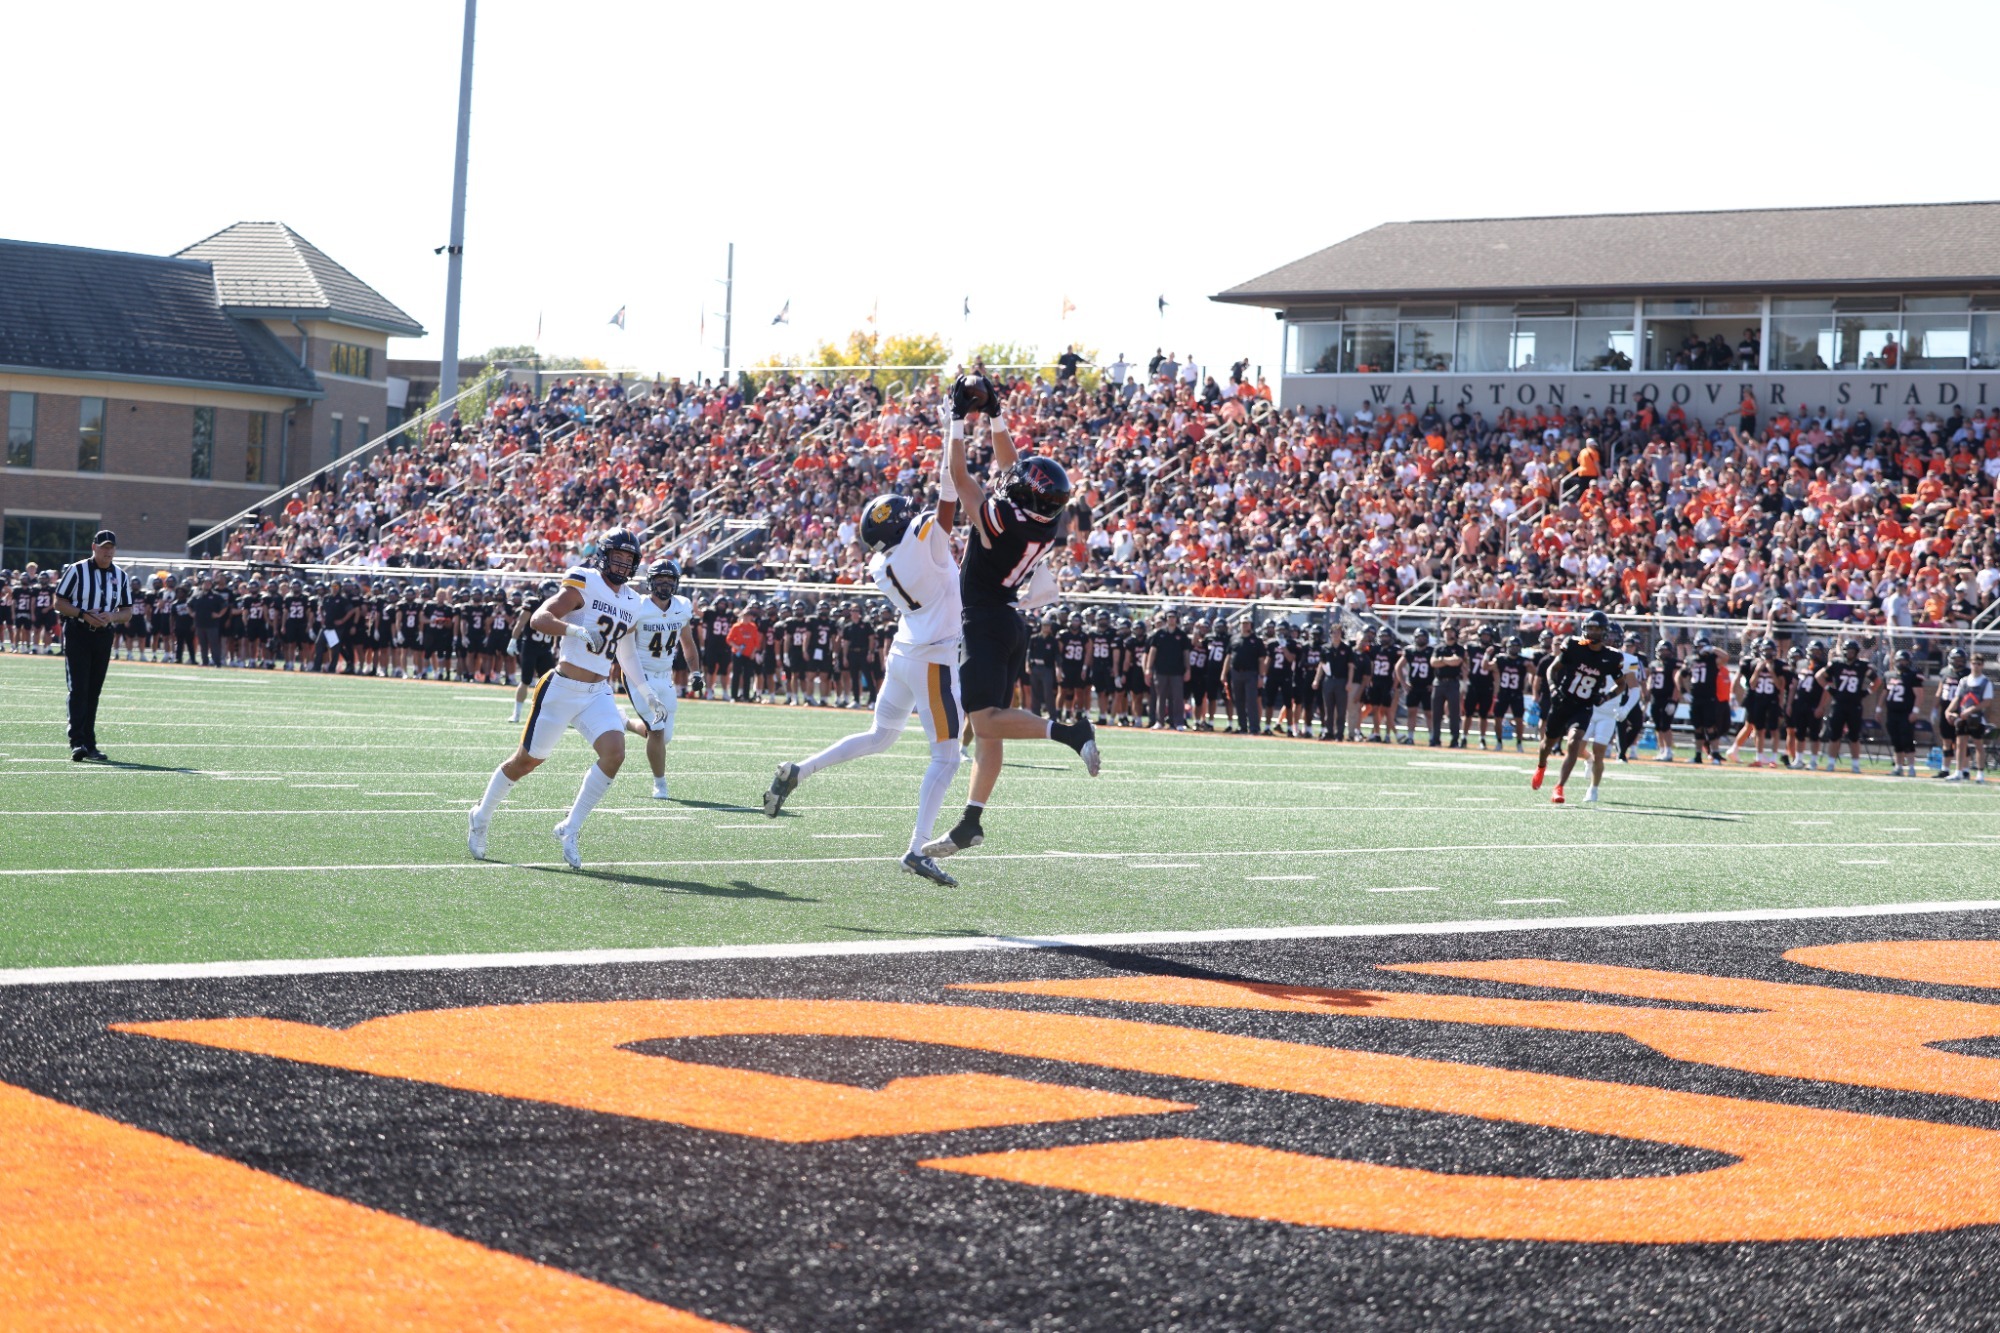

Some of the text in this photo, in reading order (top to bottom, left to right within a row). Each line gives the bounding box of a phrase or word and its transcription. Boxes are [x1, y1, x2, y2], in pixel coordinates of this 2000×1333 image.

[1836, 383, 1988, 405] STADI
[886, 564, 922, 611] 1
[249, 606, 264, 619] 27
[289, 606, 305, 619] 23
[592, 599, 617, 617] BUENA
[406, 614, 416, 628] 8
[473, 616, 482, 629] 3
[643, 623, 666, 632] BUENA
[713, 621, 730, 636] 93
[587, 615, 628, 661] 38
[648, 631, 678, 658] 44
[818, 631, 828, 646] 3
[1065, 645, 1084, 660] 38
[1274, 653, 1285, 669] 2
[1411, 662, 1429, 678] 79
[1500, 672, 1520, 690] 93
[1568, 671, 1597, 699] 18
[1755, 677, 1774, 694] 36
[1838, 675, 1859, 694] 78
